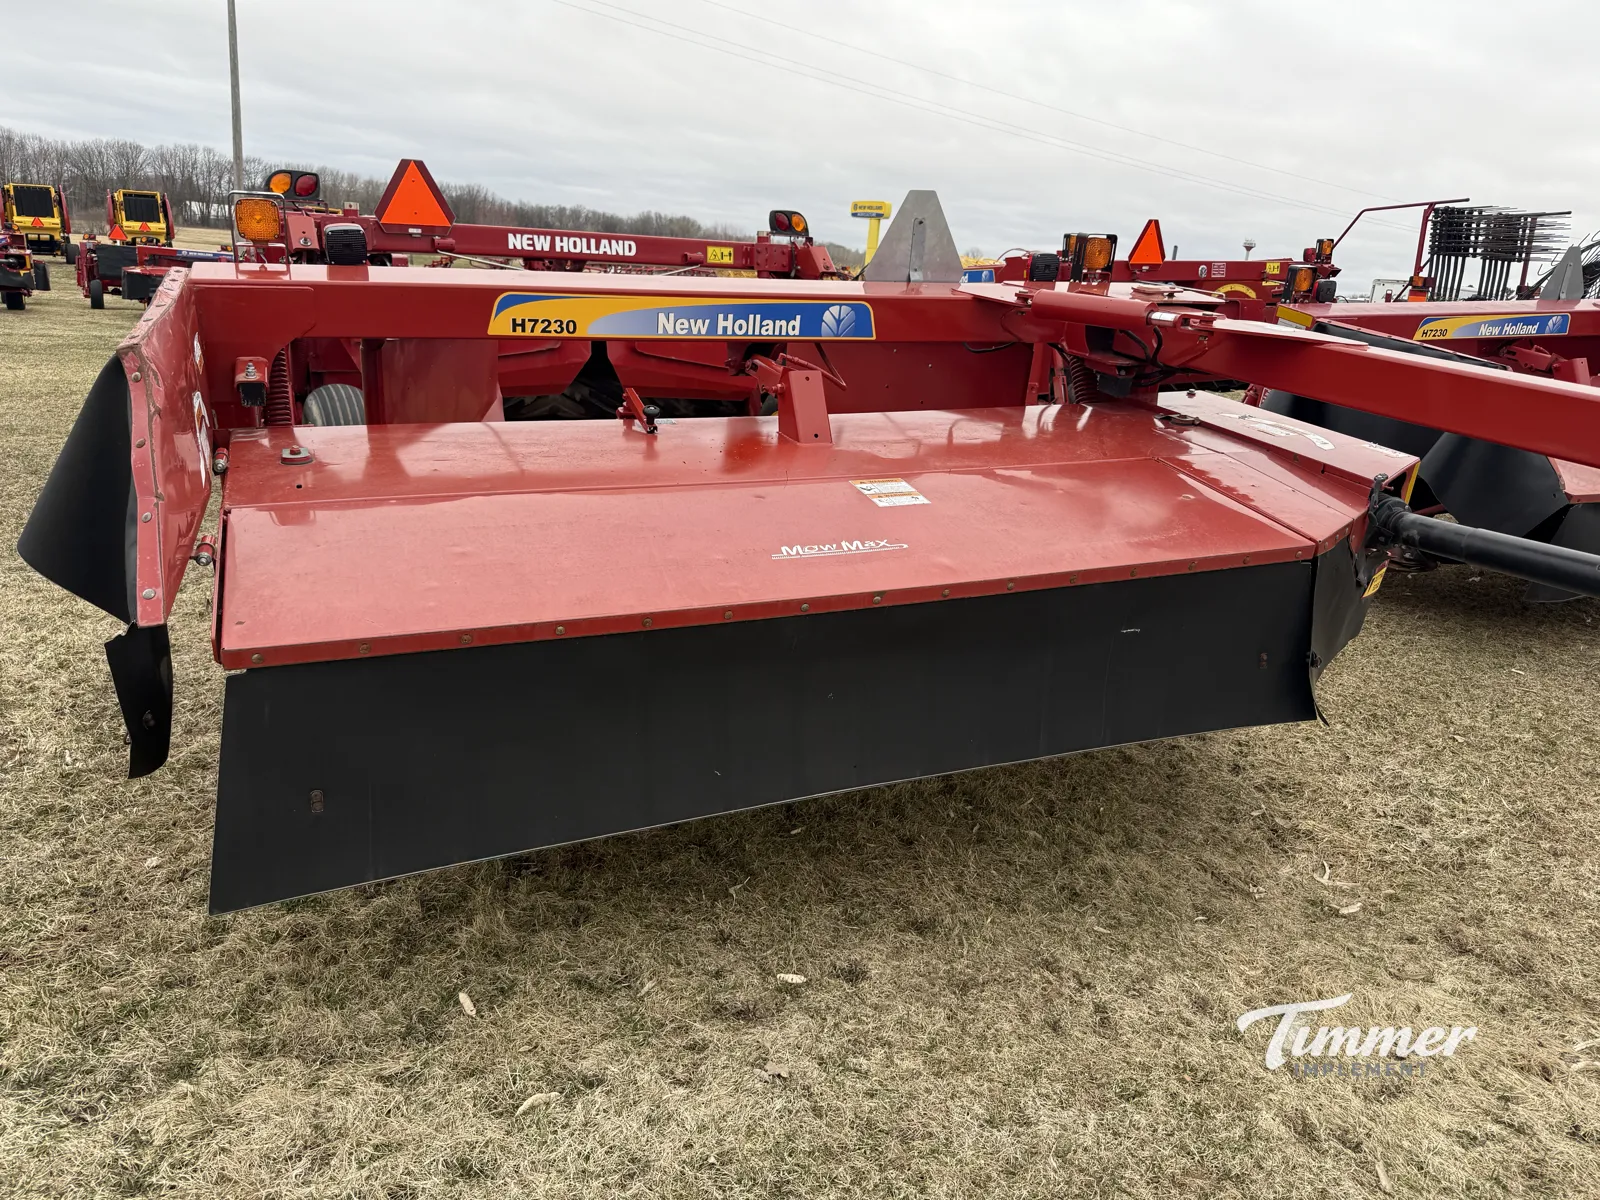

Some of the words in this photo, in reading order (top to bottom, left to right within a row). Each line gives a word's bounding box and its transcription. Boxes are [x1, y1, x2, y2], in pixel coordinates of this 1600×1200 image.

[508, 233, 551, 252] NEW
[555, 236, 636, 256] HOLLAND
[511, 318, 577, 335] H7230
[656, 312, 710, 335] New
[716, 313, 801, 336] Holland
[1478, 323, 1502, 336] New
[1502, 322, 1540, 335] Holland
[1421, 328, 1448, 338] H7230
[780, 543, 837, 556] Mow
[841, 538, 889, 551] Max
